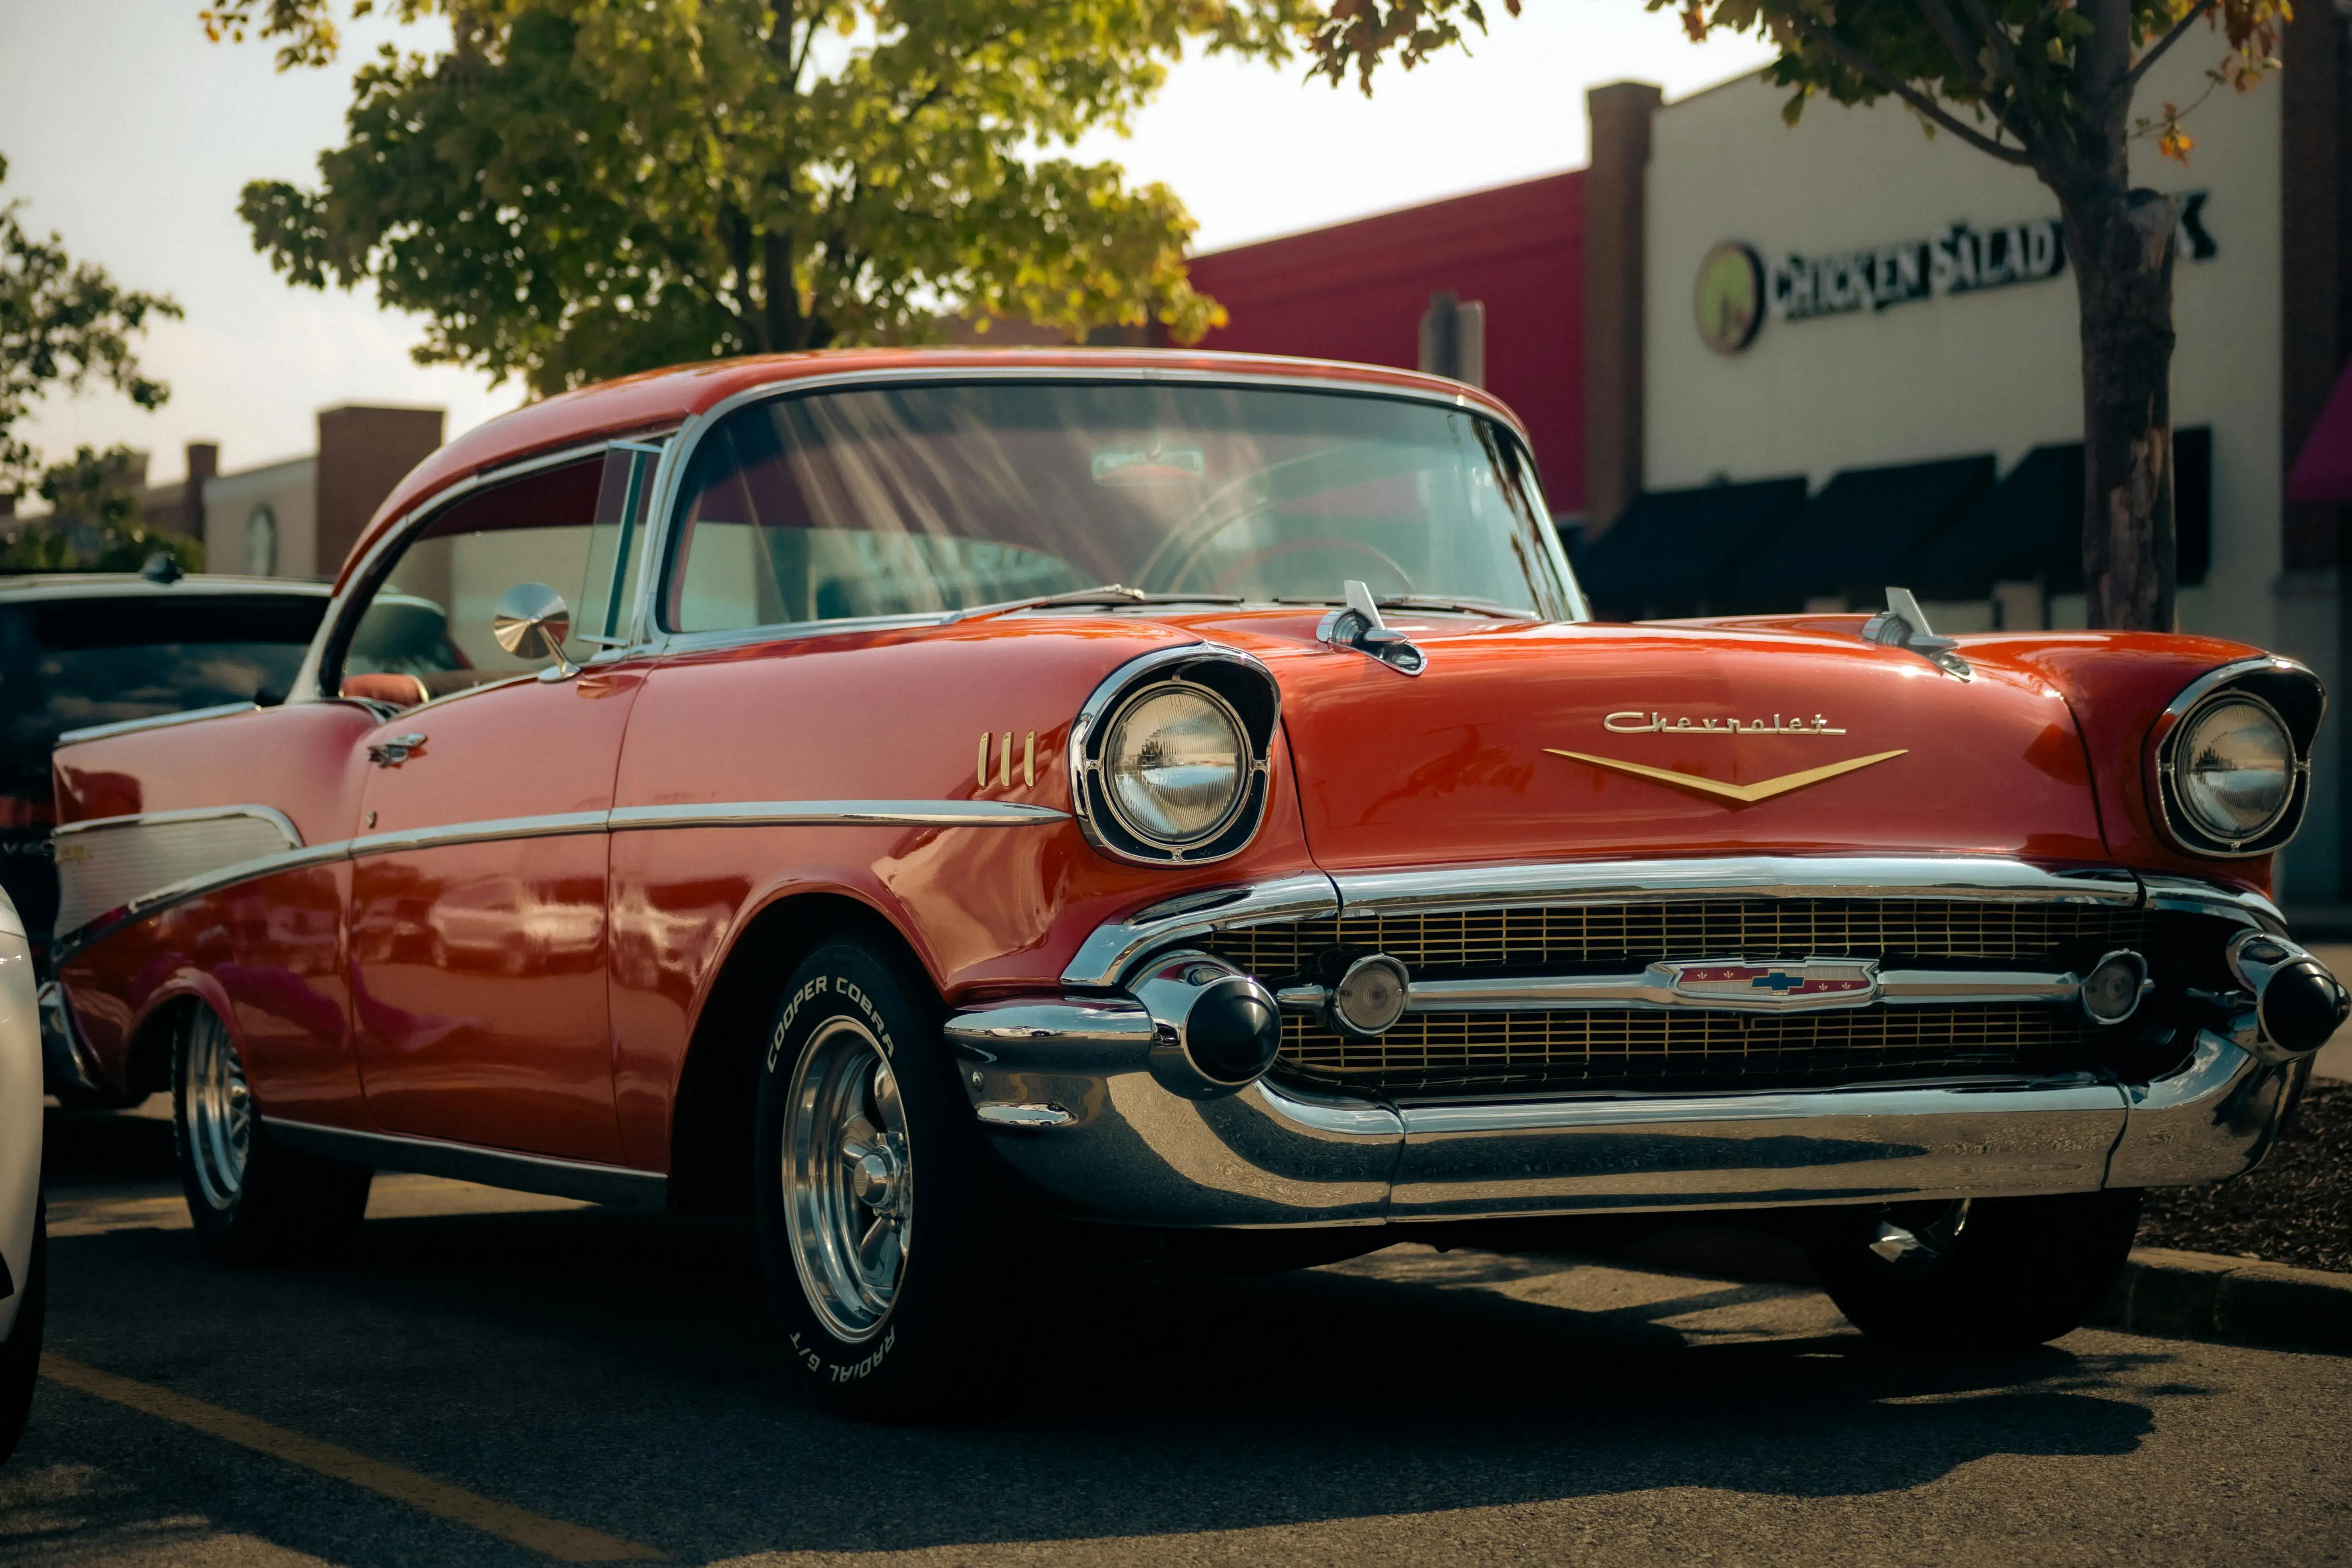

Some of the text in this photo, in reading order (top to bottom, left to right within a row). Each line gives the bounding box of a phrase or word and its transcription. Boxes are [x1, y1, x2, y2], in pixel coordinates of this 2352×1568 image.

[1766, 220, 2060, 316] CHICKEN SALAD
[1604, 711, 1847, 735] Chevrolet
[767, 975, 894, 1073] COOPER COBRA
[829, 1324, 896, 1382] RADIAL
